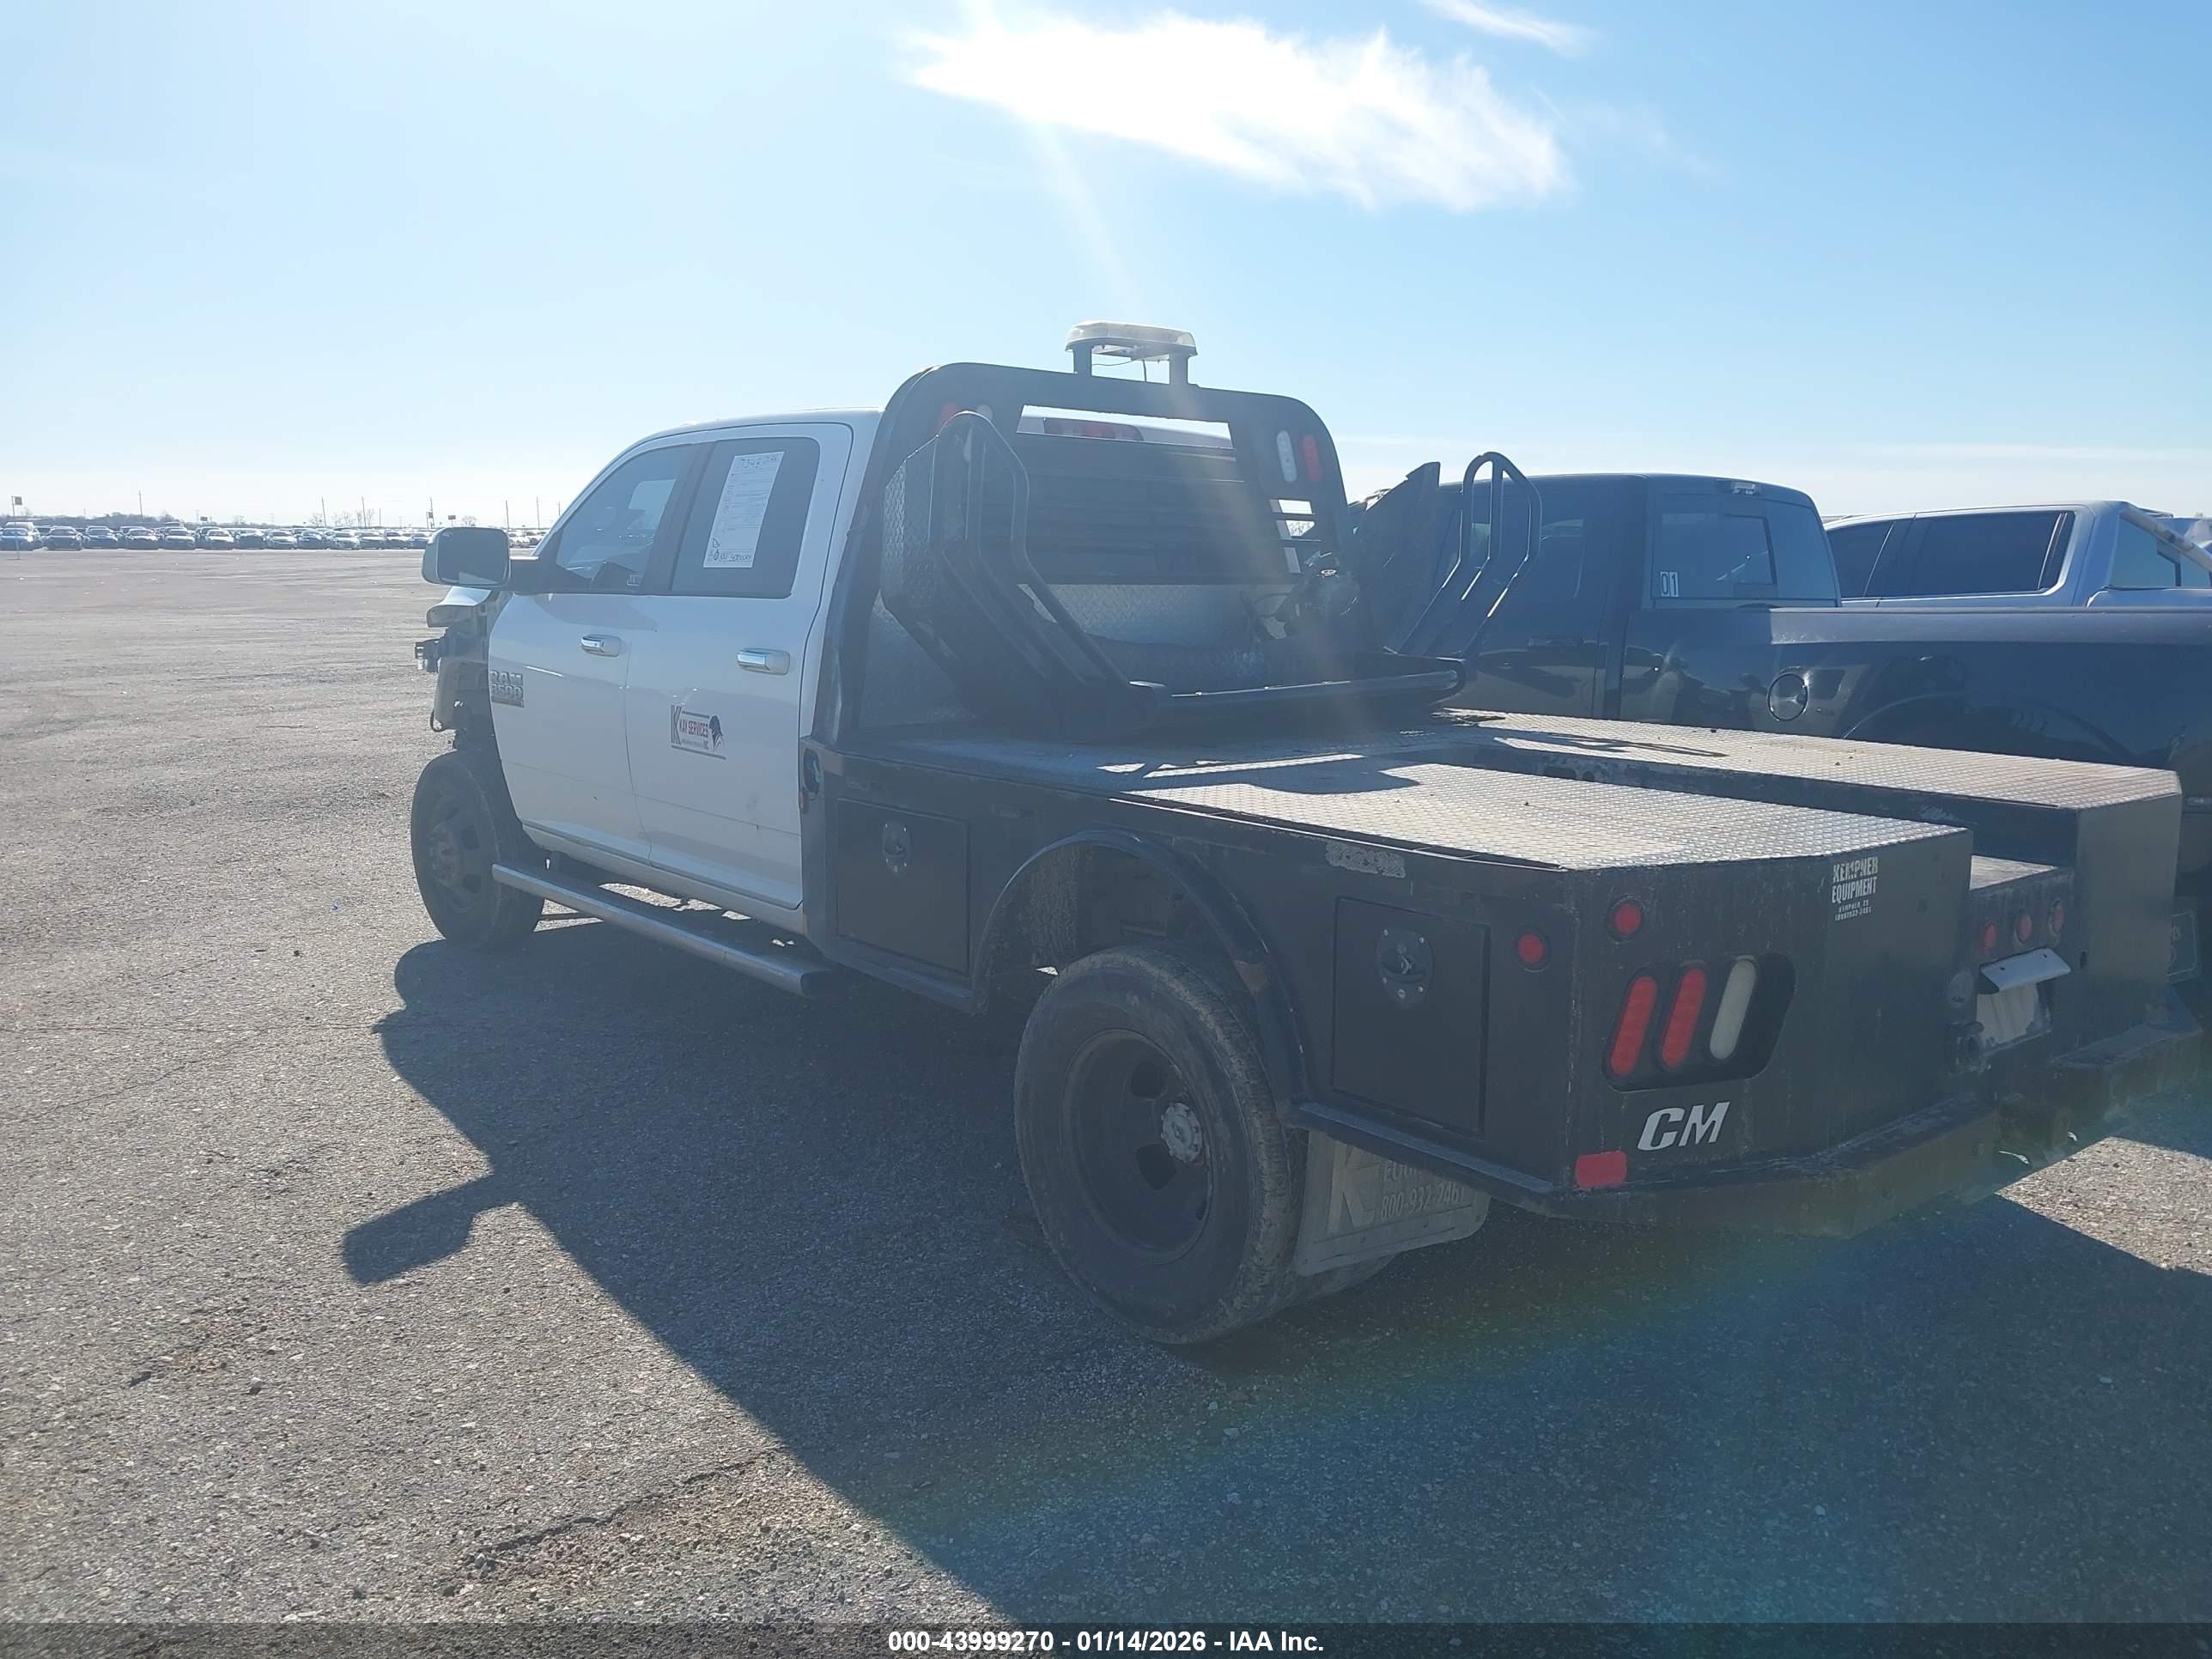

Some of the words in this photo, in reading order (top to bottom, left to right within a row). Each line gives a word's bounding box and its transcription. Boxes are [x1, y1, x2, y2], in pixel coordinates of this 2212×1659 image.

[1661, 572, 1677, 597] 01
[489, 670, 523, 686] RAM
[688, 720, 708, 738] SERVICES
[1833, 856, 1879, 883] KEMPNER
[1832, 877, 1877, 903] EQUIPMENT
[1637, 1102, 1730, 1151] CM
